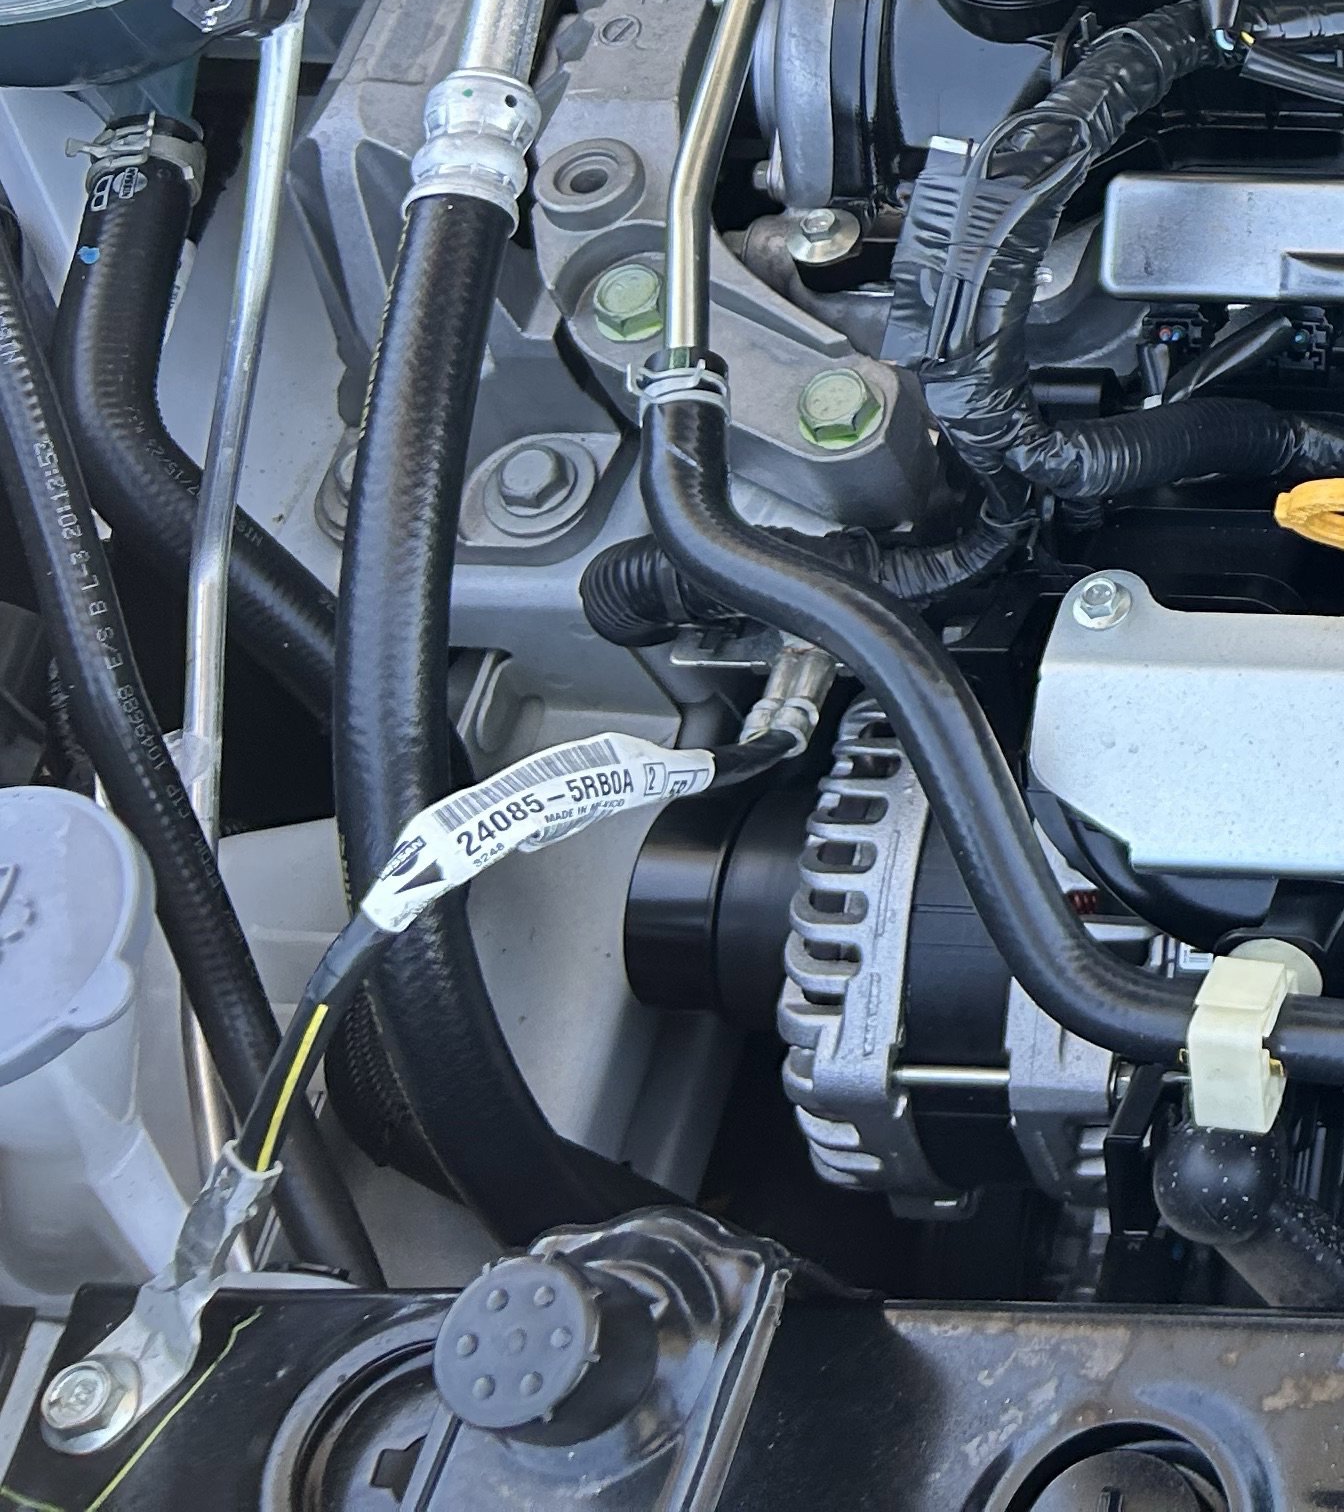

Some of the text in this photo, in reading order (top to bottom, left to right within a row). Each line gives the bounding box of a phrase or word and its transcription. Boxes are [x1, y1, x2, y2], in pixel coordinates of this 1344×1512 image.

[32, 437, 84, 541] 20:12:53
[115, 683, 168, 772] 1049688
[545, 809, 575, 825] MADE
